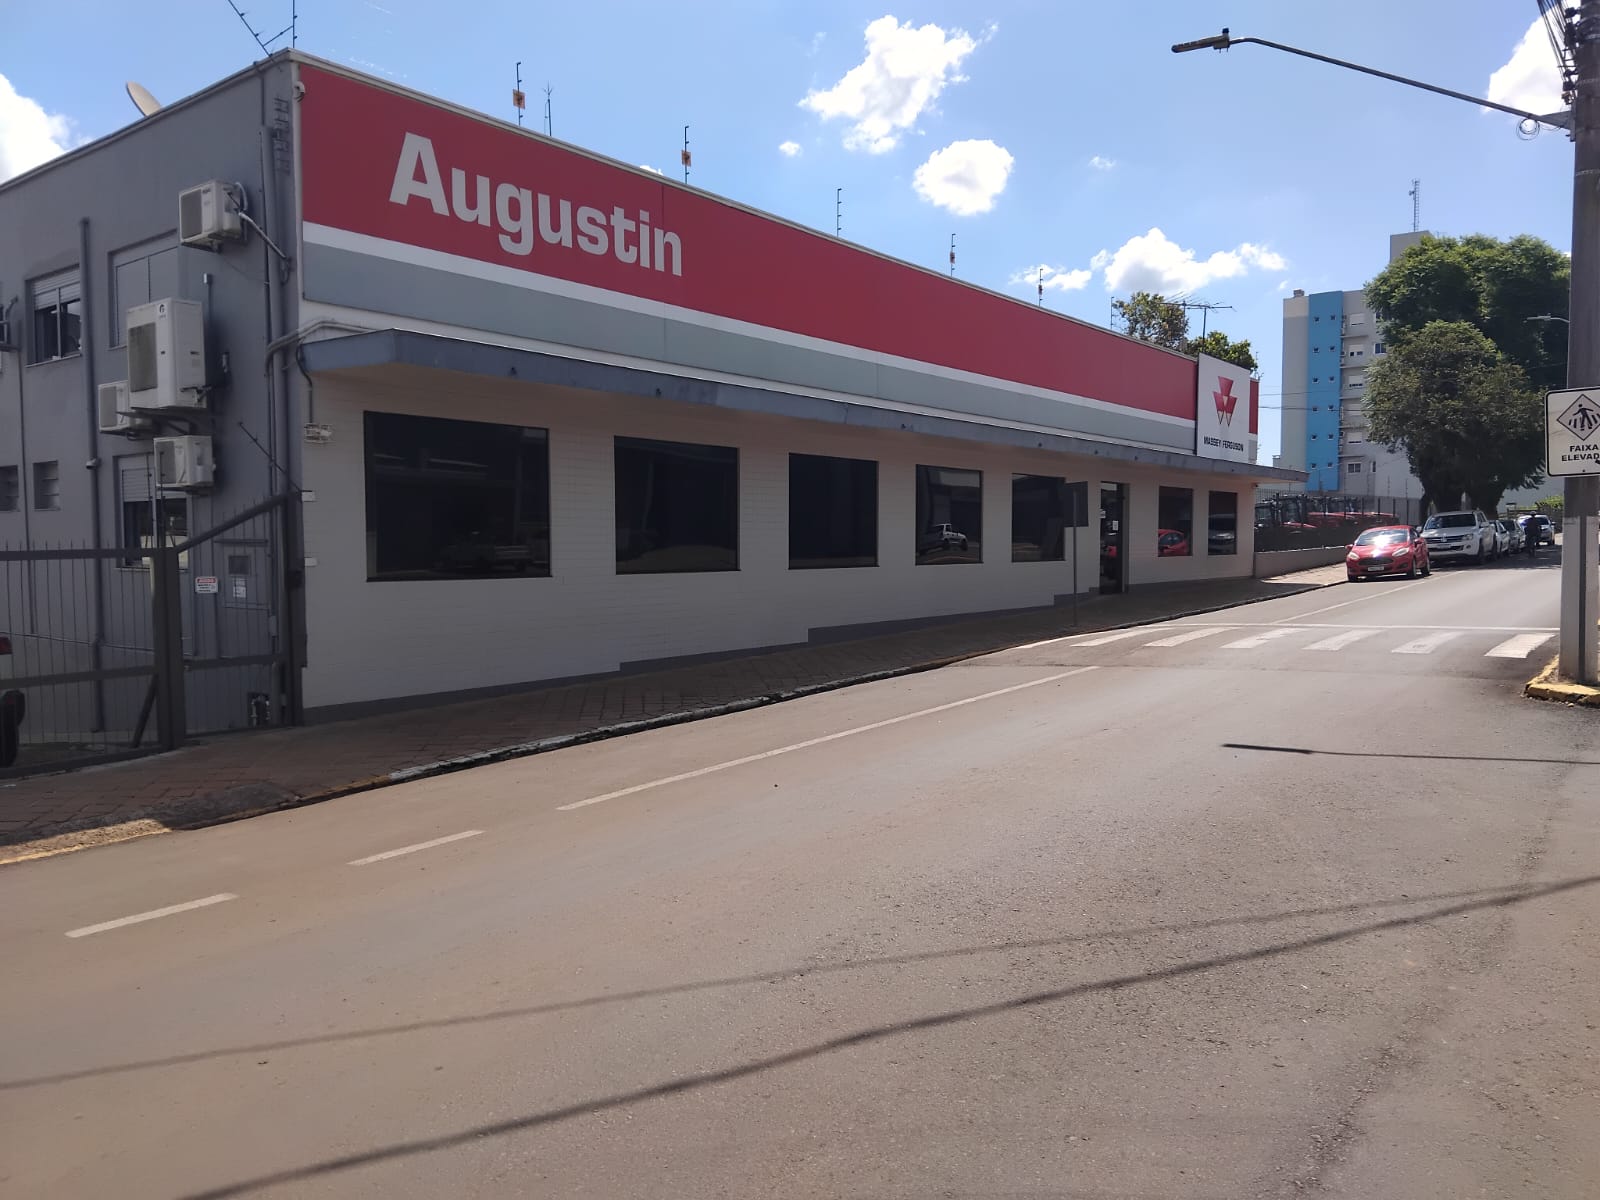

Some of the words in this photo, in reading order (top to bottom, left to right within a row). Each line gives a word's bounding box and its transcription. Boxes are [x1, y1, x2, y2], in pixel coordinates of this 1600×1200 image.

[389, 131, 682, 277] Augustin
[1203, 435, 1221, 447] MASSEY
[1222, 440, 1244, 452] FERGUSON
[1569, 444, 1599, 452] FAIXA
[1561, 453, 1600, 461] ELEVAD
